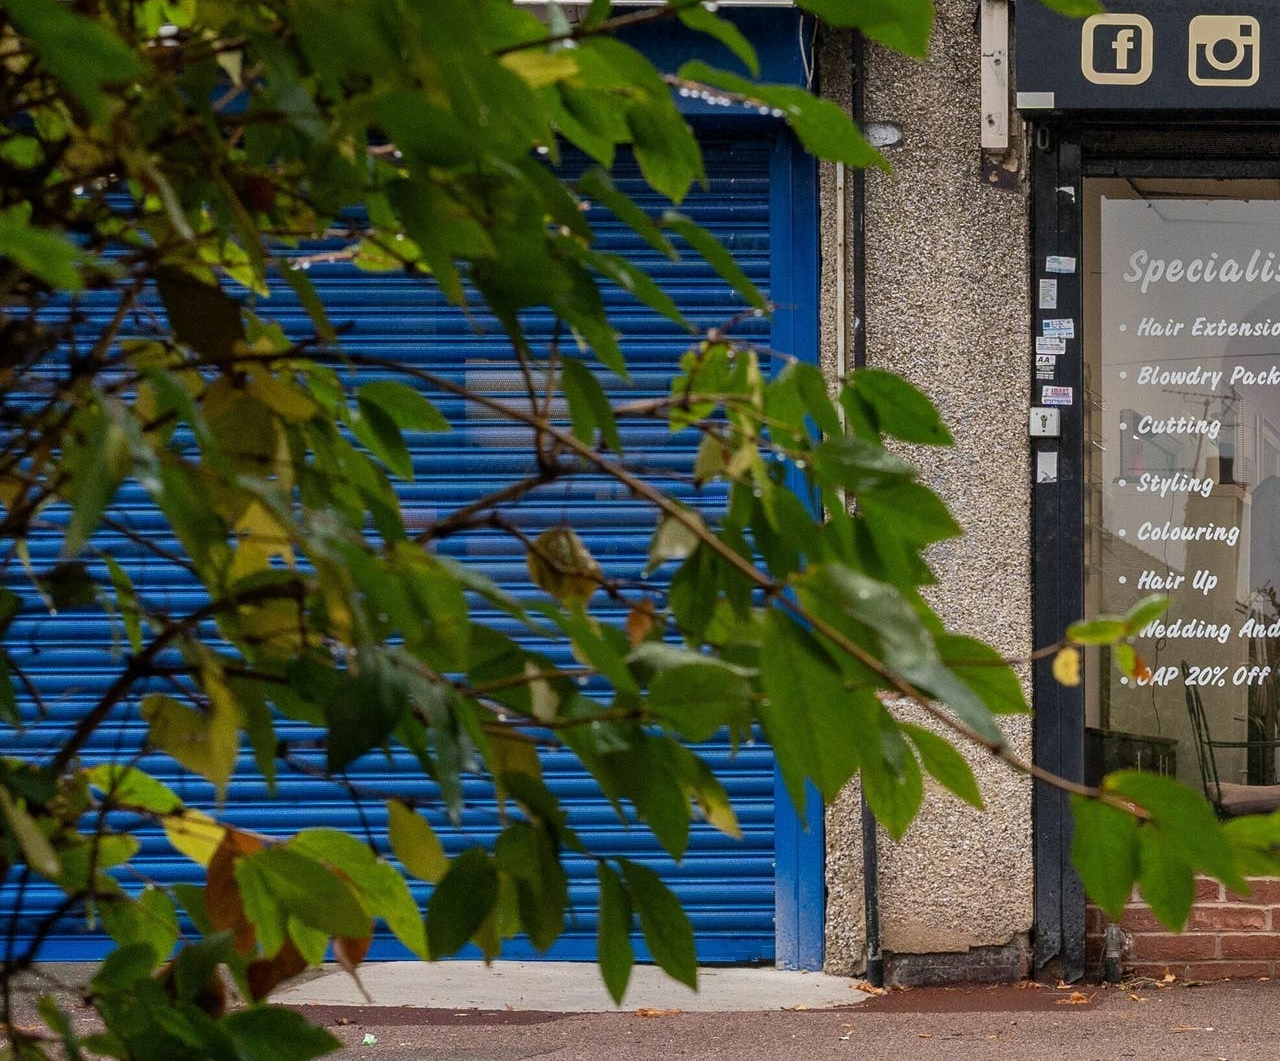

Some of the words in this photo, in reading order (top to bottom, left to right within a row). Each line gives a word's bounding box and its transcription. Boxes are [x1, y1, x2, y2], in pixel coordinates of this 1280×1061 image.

[1136, 317, 1185, 337] Hair
[1136, 366, 1223, 390] Blowdry
[1136, 416, 1222, 439] Cutting
[1136, 474, 1214, 498] Styling
[1136, 523, 1241, 546] Colouring
[1136, 571, 1186, 590] Hair
[1193, 571, 1218, 595] Up
[1139, 618, 1231, 644] Wedding
[1185, 666, 1229, 687] 20%
[1233, 666, 1271, 686] Off
